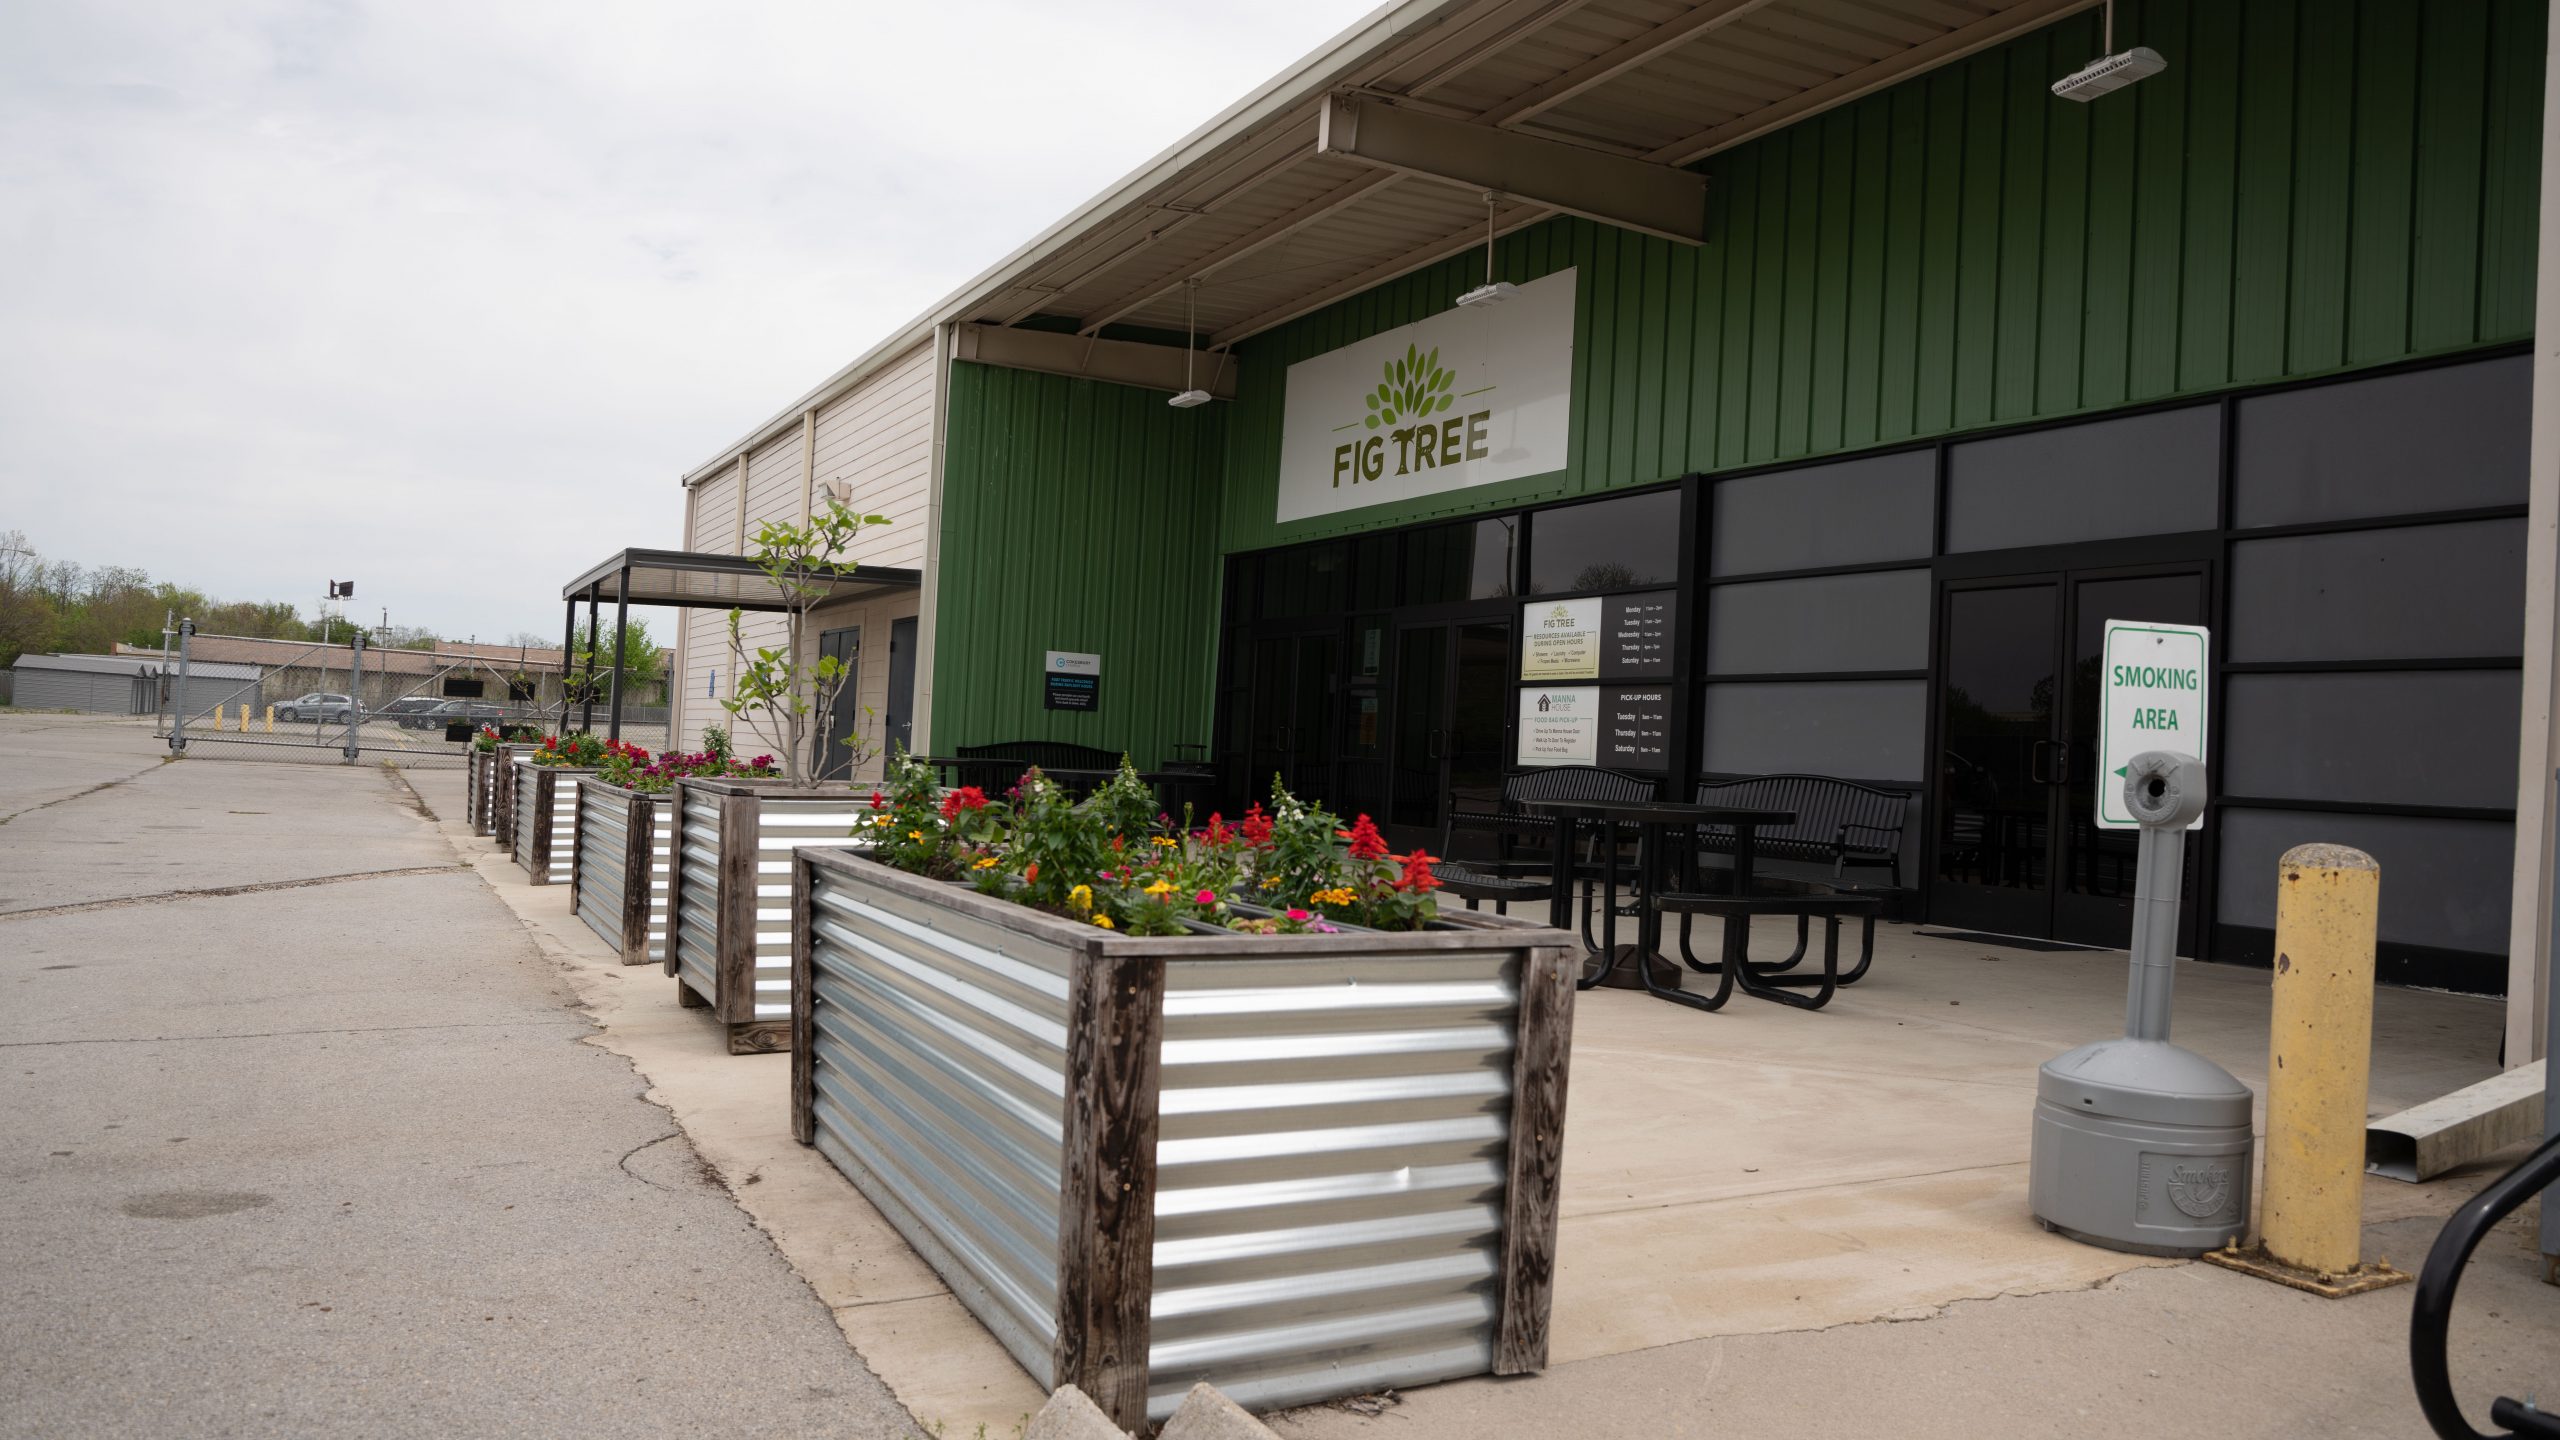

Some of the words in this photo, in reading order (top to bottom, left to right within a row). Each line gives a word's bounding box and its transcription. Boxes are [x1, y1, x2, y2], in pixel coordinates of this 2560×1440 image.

[1333, 436, 1384, 488] FIG
[1390, 410, 1491, 476] TREE
[1543, 619, 1555, 628] FIG
[1556, 618, 1575, 627] TREE
[2114, 665, 2197, 690] SMOKING
[1552, 695, 1576, 703] MANNA
[1617, 712, 1636, 722] Tuesday
[2132, 708, 2178, 730] AREA
[1615, 729, 1636, 738] Thursday
[1615, 744, 1635, 754] Saturday
